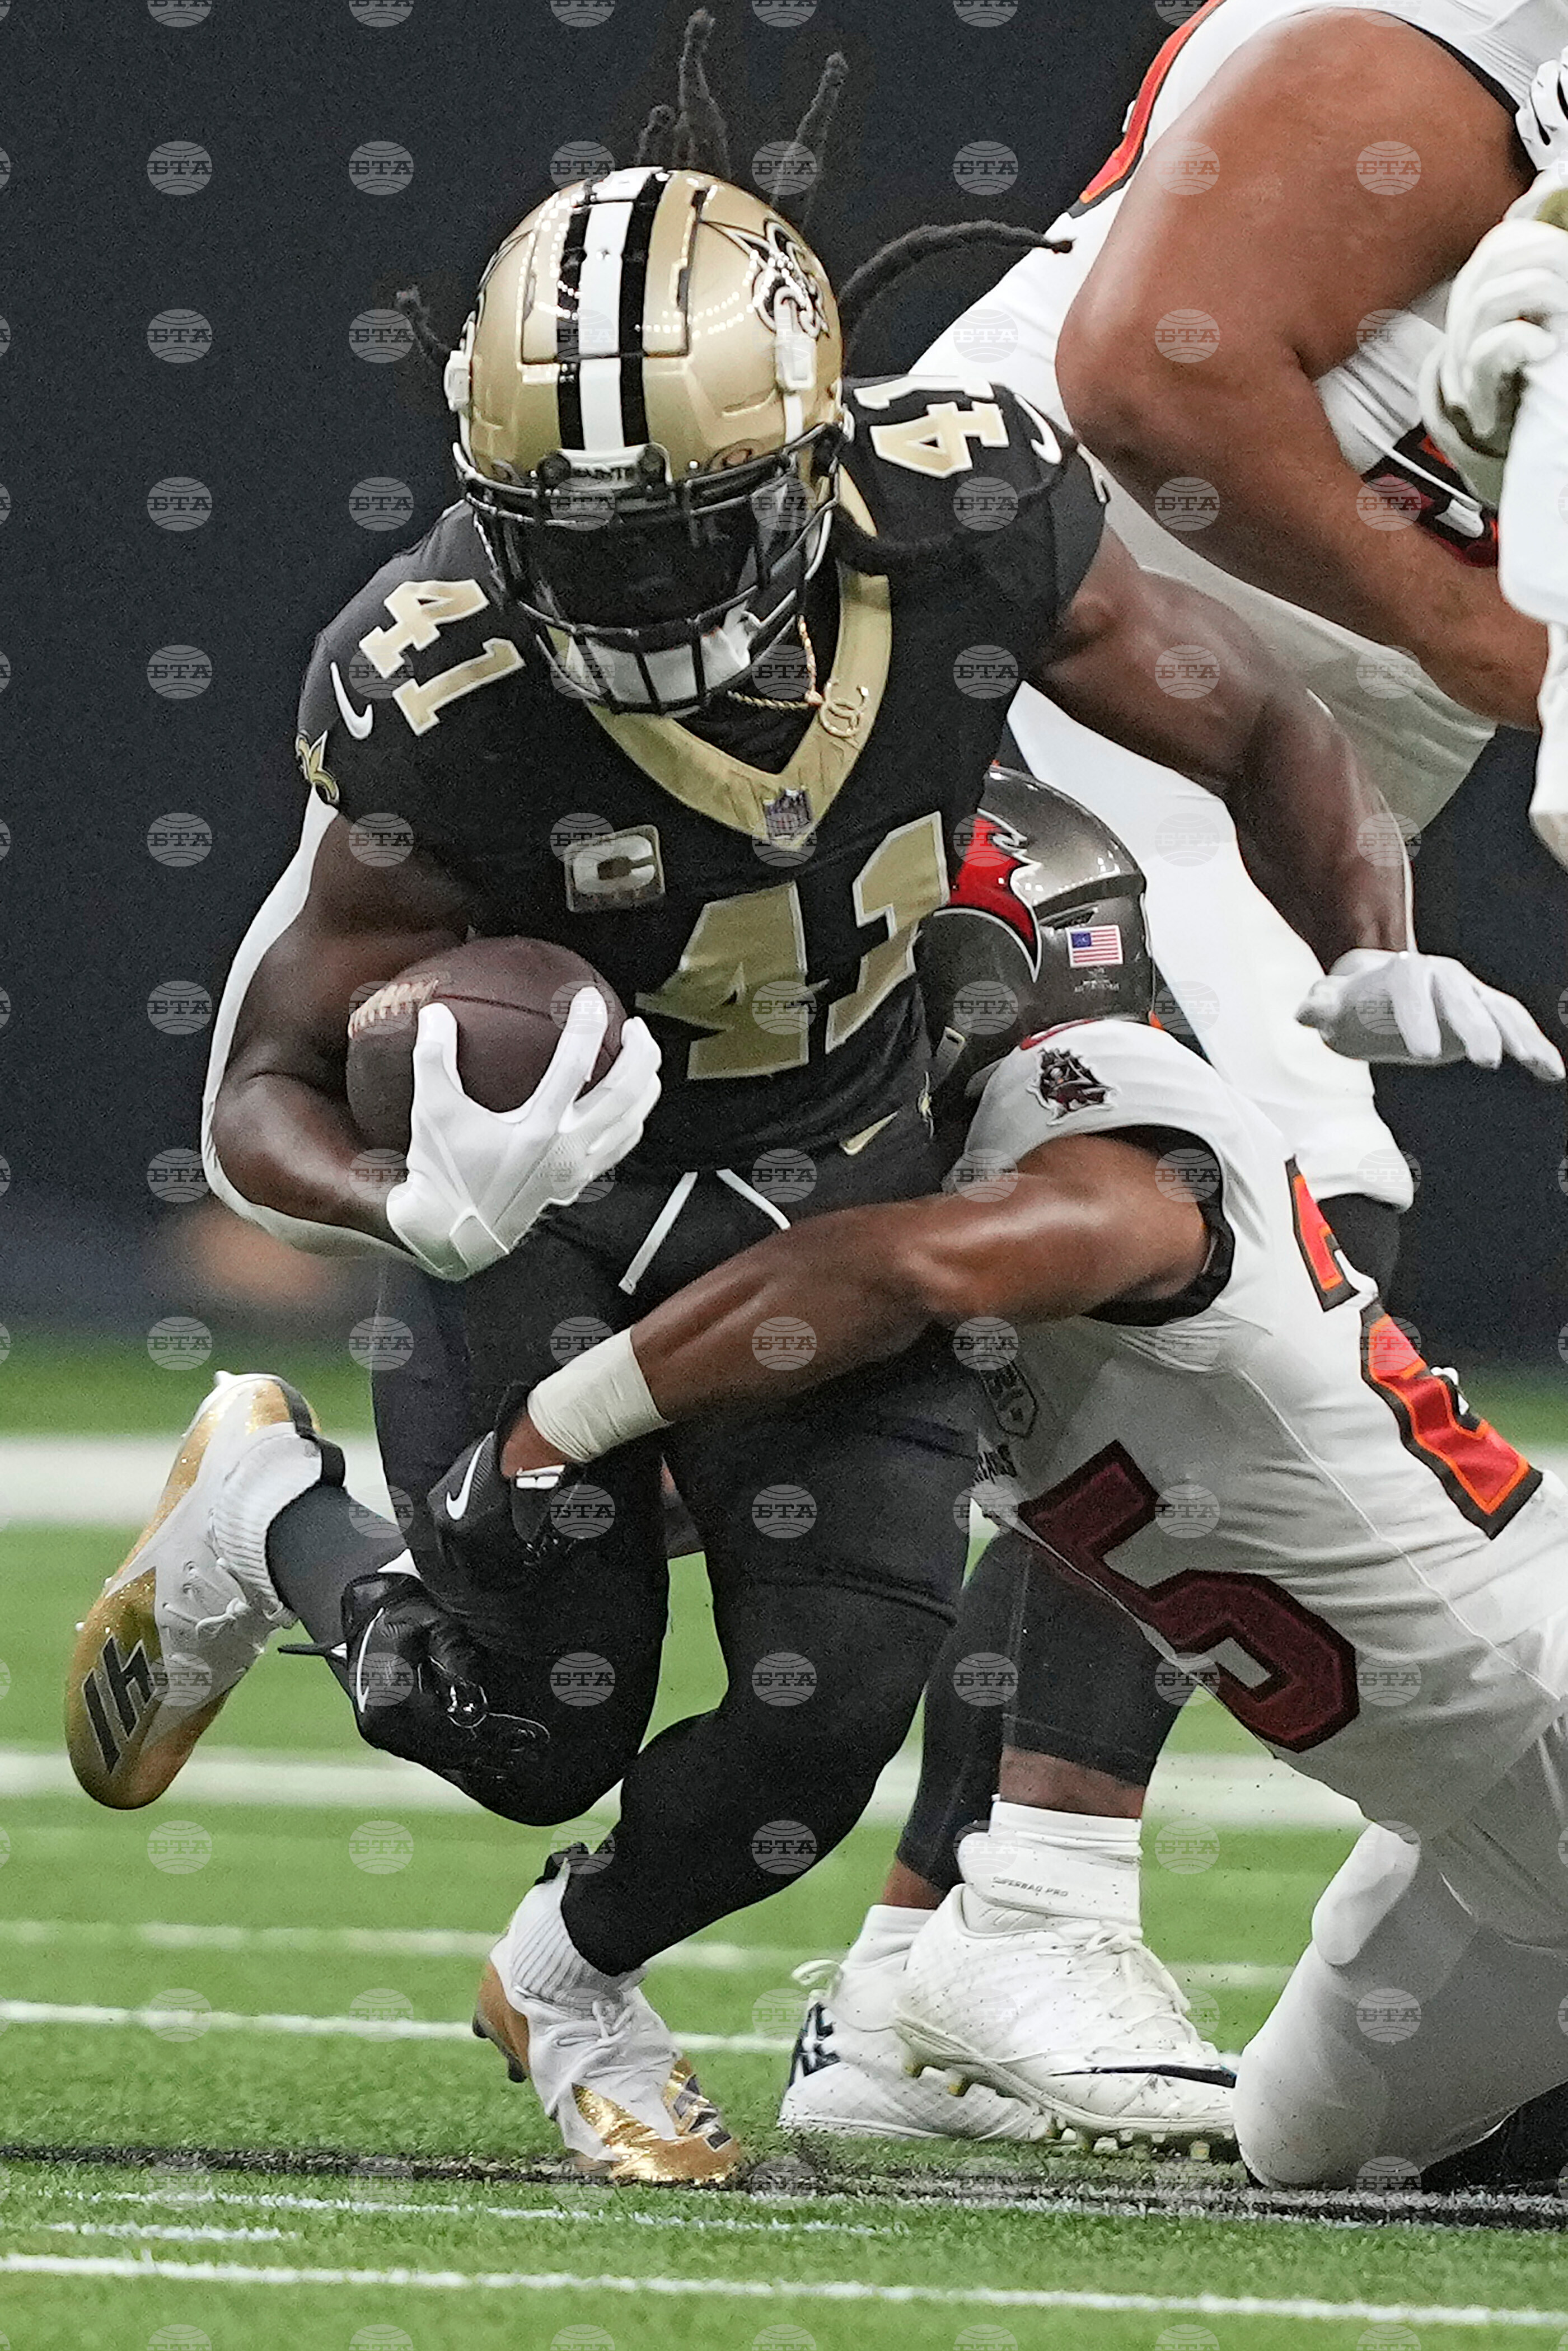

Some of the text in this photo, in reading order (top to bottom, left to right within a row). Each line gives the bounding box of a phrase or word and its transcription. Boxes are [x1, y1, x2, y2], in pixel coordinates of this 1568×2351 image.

[854, 376, 1009, 479] 41
[359, 579, 526, 737] 41
[573, 835, 655, 894] C
[635, 811, 950, 1080] 41
